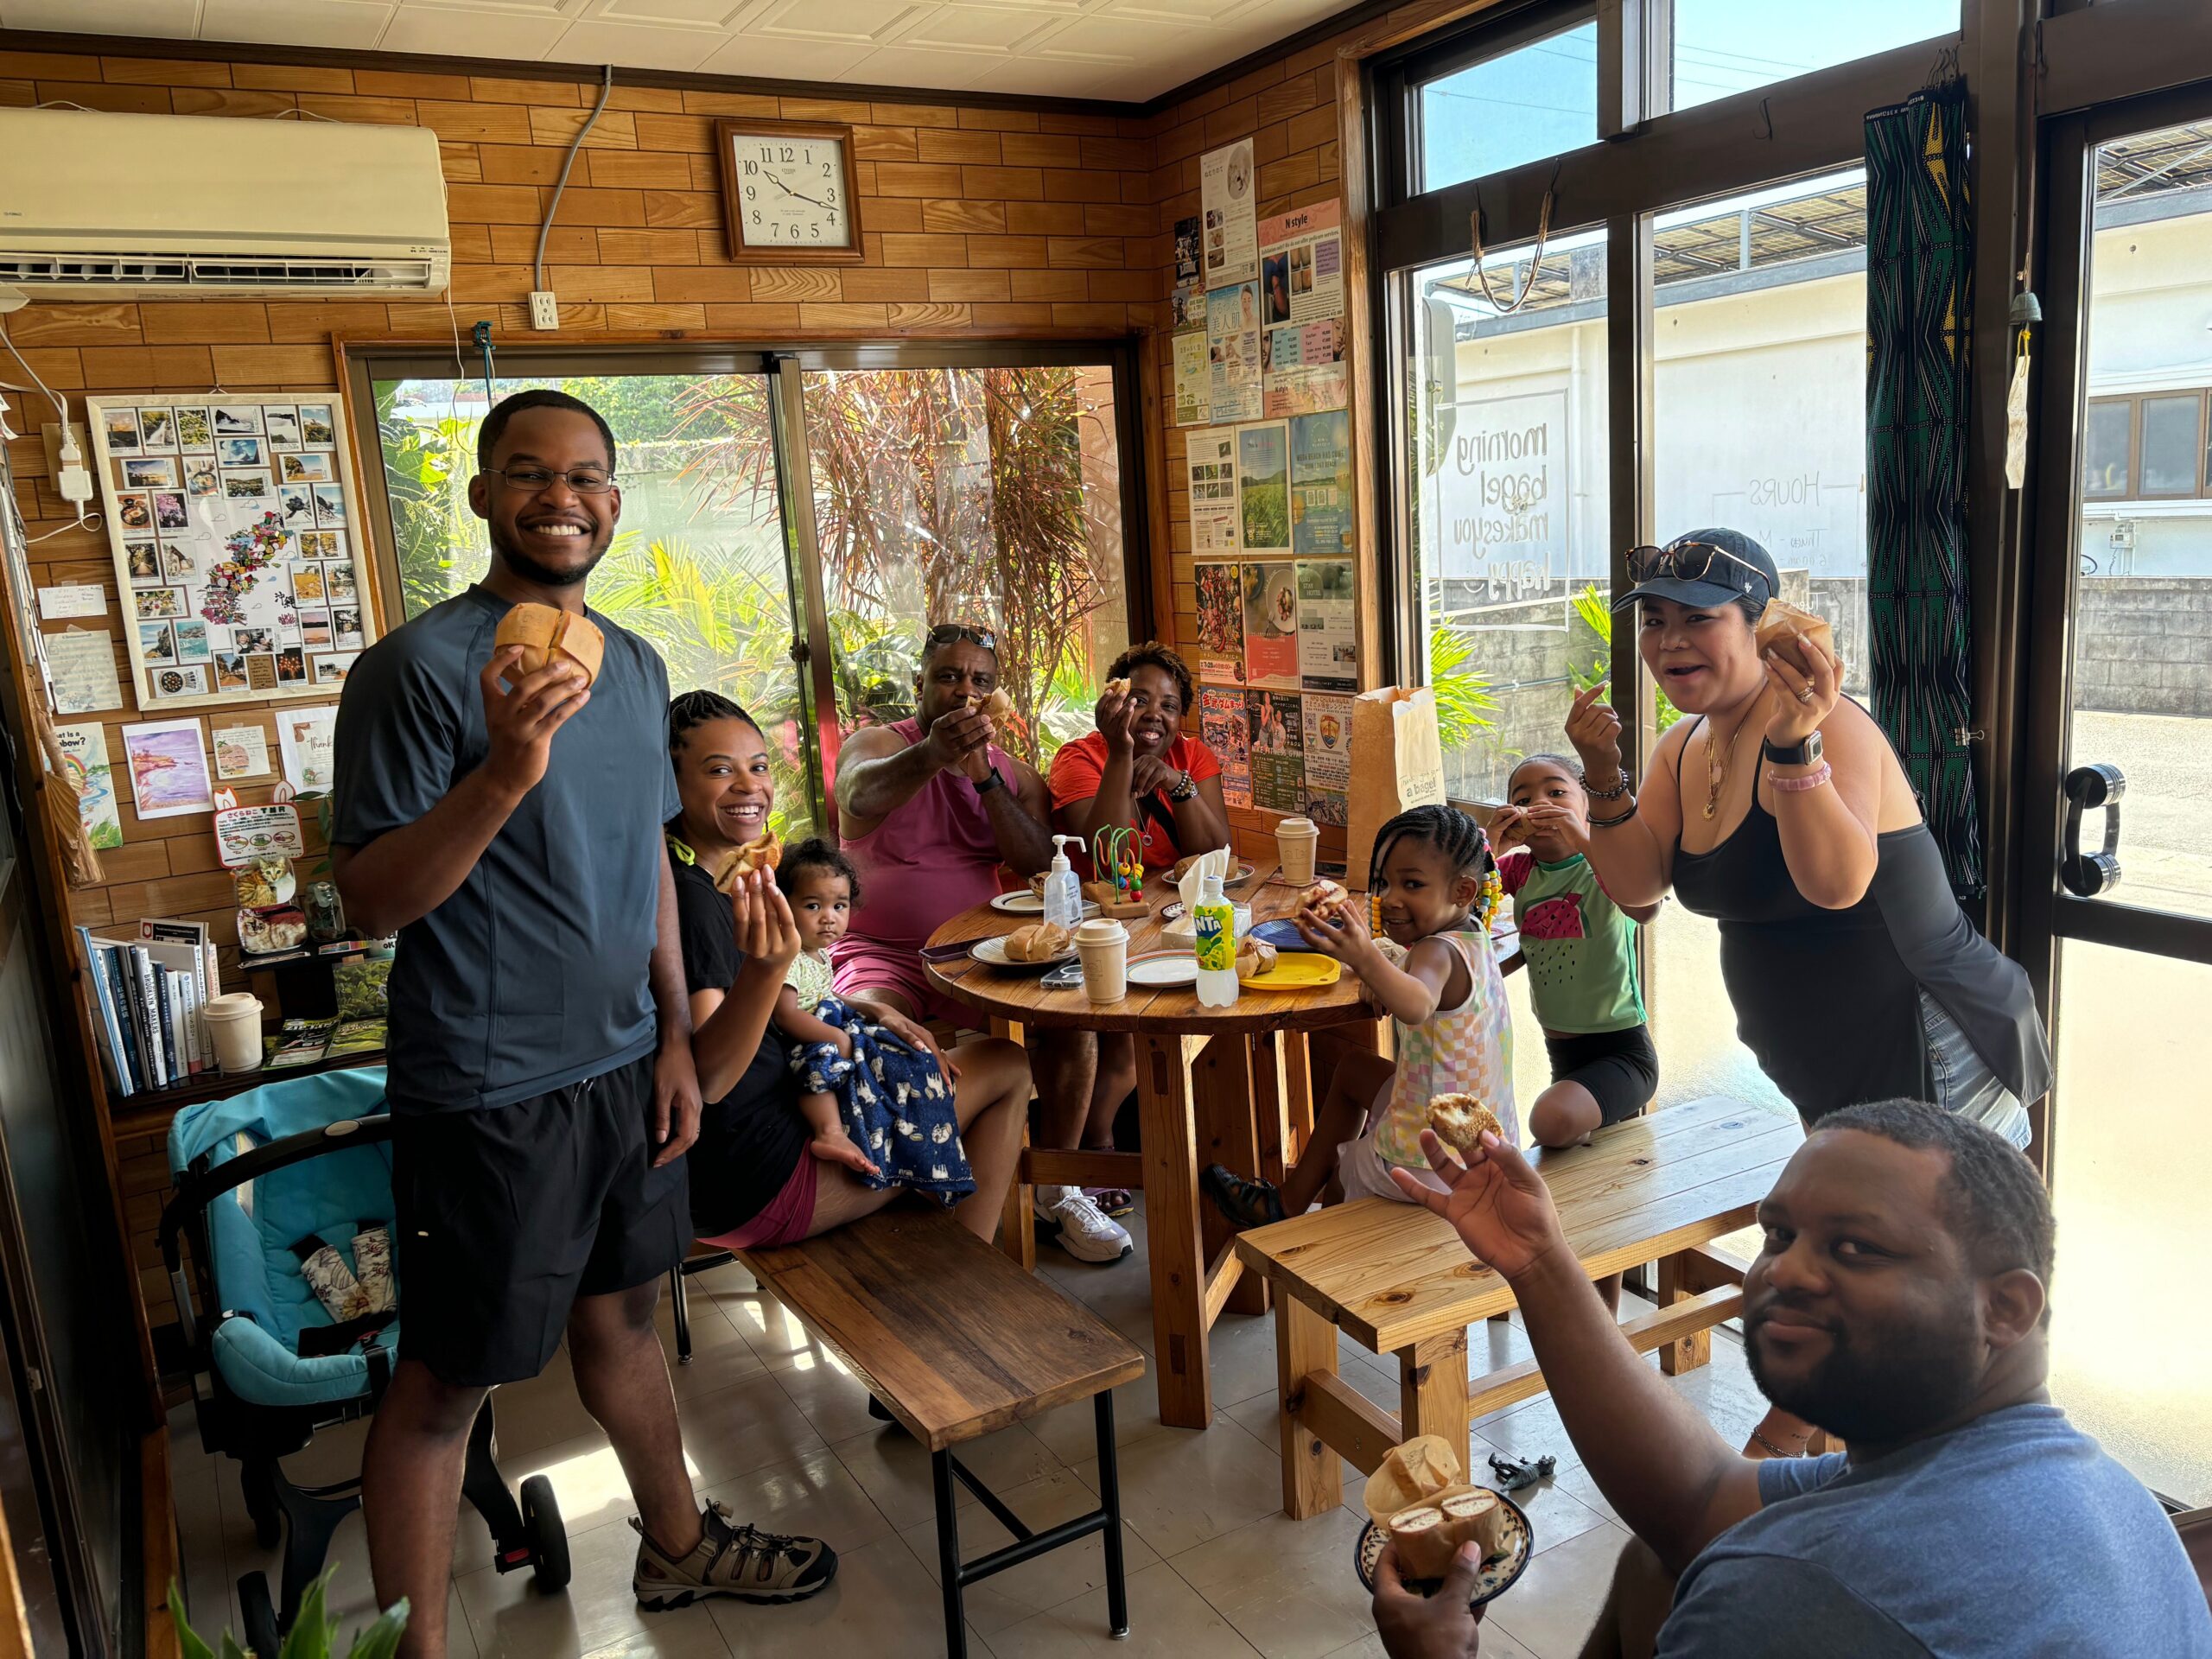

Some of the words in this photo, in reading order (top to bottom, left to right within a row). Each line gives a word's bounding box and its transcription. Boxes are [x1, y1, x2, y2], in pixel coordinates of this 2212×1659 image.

[760, 148, 773, 163] 11
[779, 148, 794, 162] 12
[804, 149, 812, 164] 1
[743, 160, 758, 175] 10
[822, 162, 831, 177] 2
[746, 186, 756, 200] 9
[827, 188, 836, 202] 3
[752, 210, 761, 224] 8
[826, 213, 836, 226] 4
[1291, 213, 1308, 228] style
[771, 223, 779, 238] 7
[790, 224, 799, 238] 6
[810, 223, 819, 238] 5
[1211, 311, 1241, 333] 美人肌
[1406, 787, 1414, 798] a
[1414, 777, 1436, 795] bagel
[1195, 915, 1223, 932] NTA
[143, 974, 156, 1006] BROOKLYN
[149, 1007, 159, 1035] MAKERS
